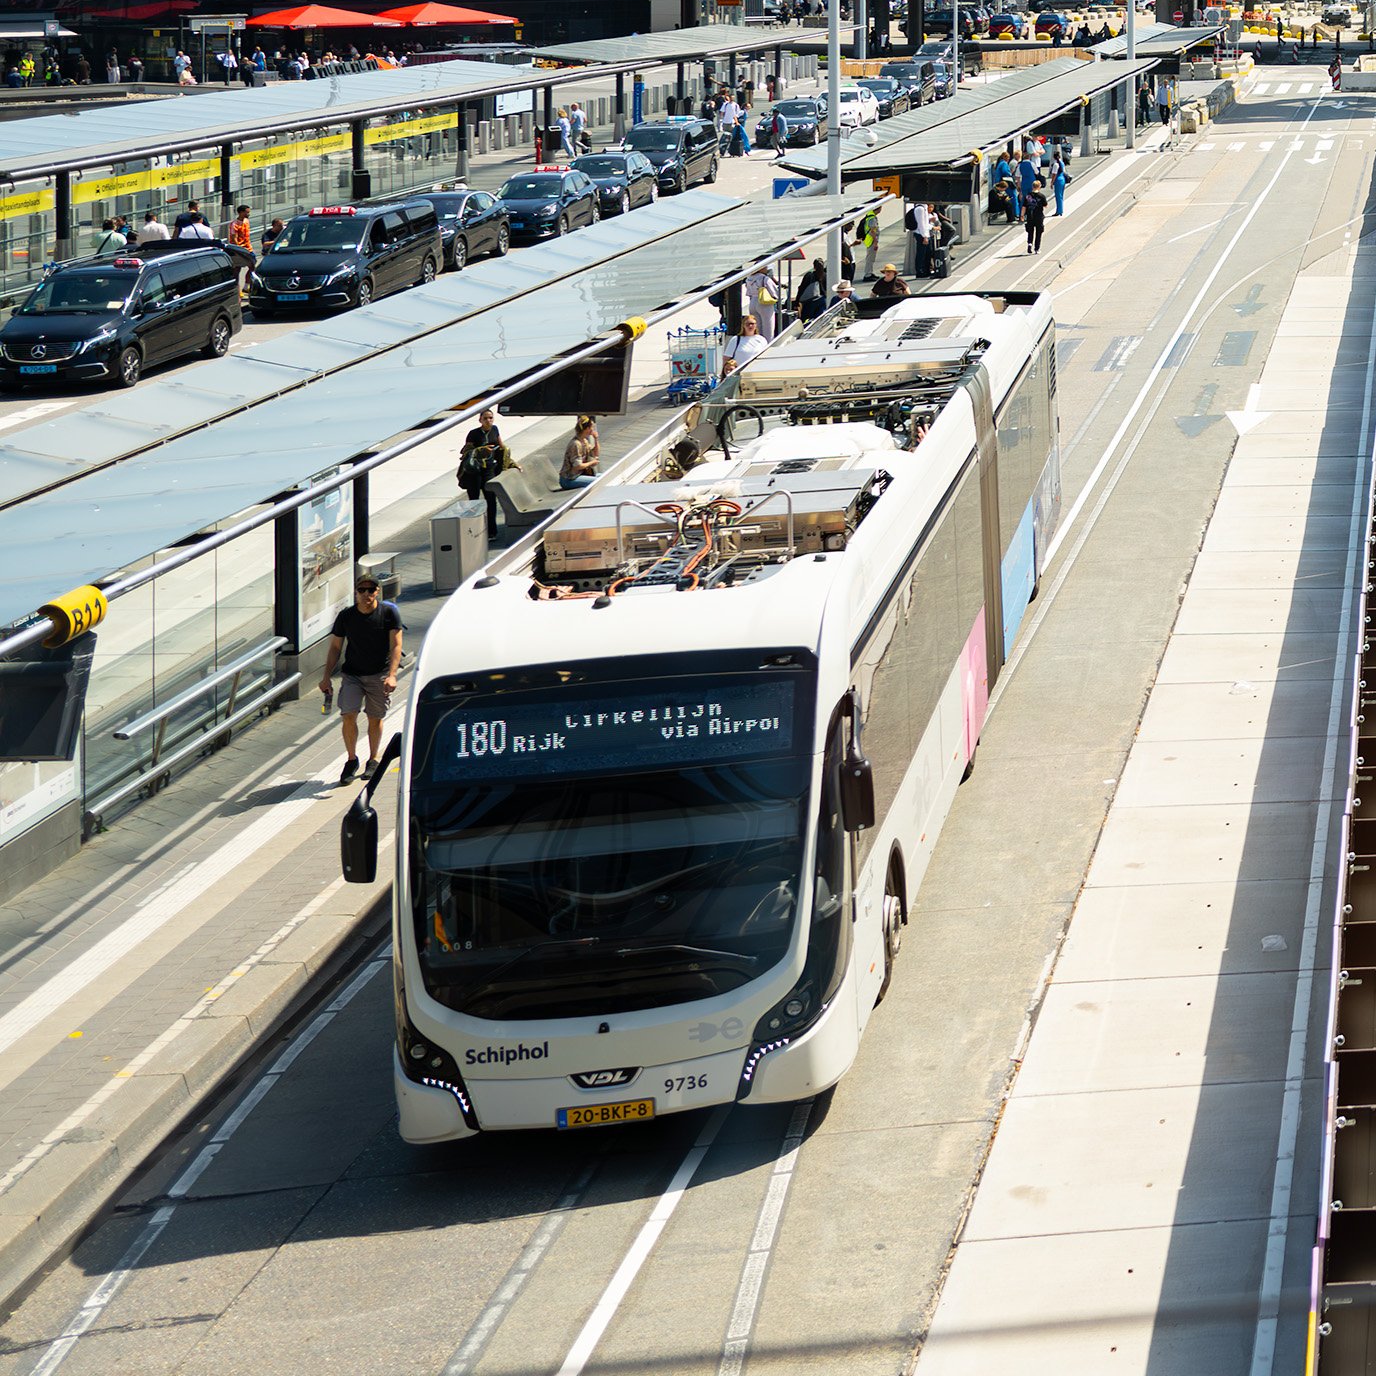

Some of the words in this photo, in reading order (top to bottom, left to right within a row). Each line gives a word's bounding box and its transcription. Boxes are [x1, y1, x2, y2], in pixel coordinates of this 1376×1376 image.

[71, 597, 103, 636] B11
[456, 720, 507, 758] 180
[512, 732, 566, 753] Rijk
[661, 723, 699, 740] via
[465, 1041, 549, 1066] Schiphol
[664, 1074, 708, 1094] 9736
[572, 1103, 648, 1125] 20-BKF-8
